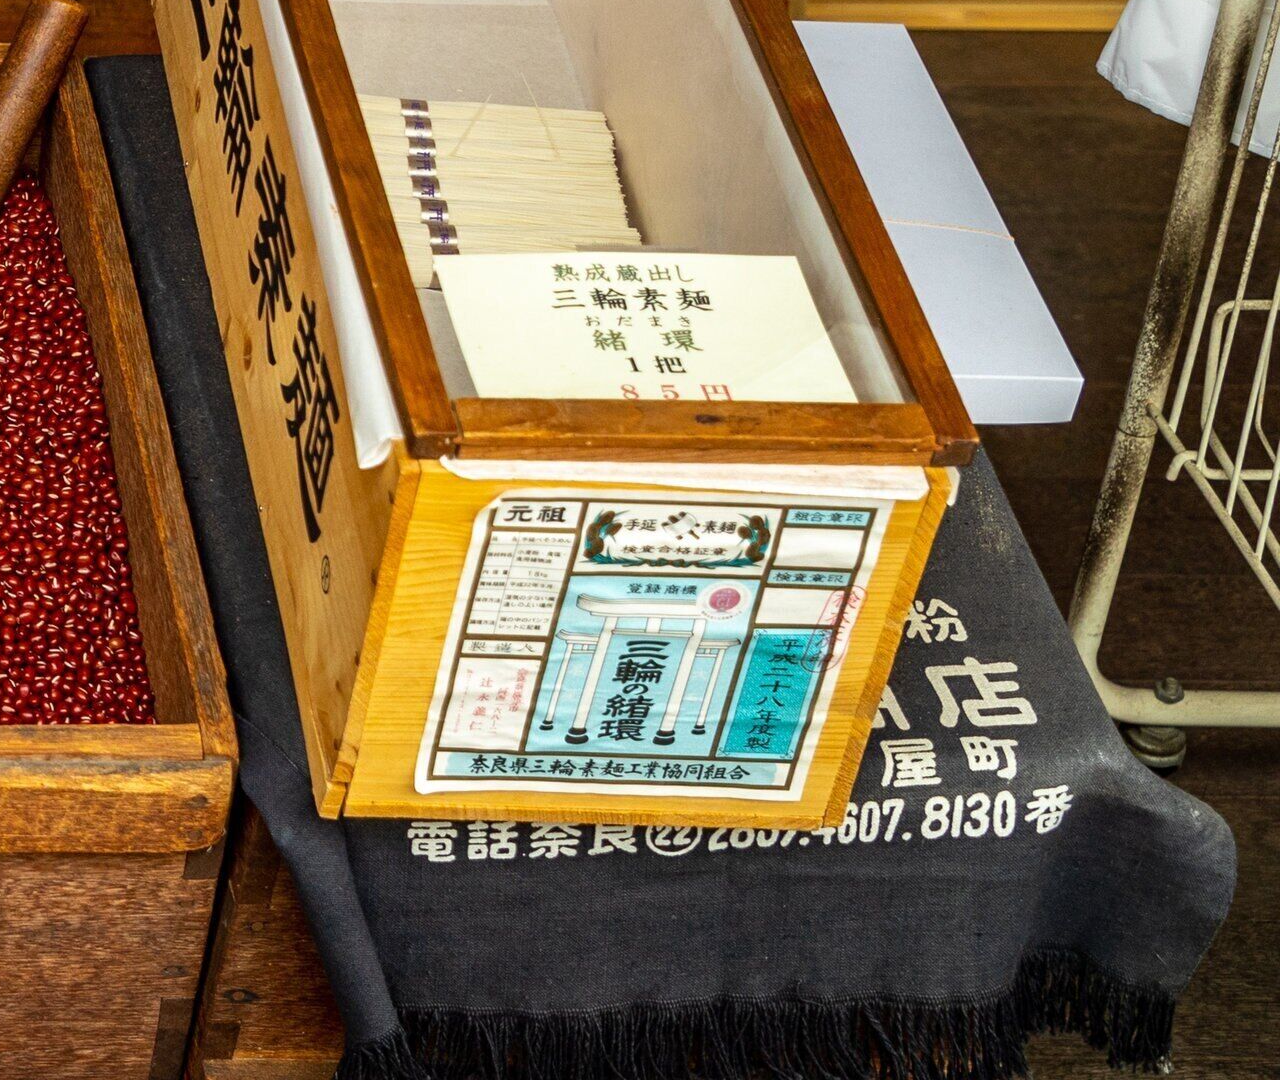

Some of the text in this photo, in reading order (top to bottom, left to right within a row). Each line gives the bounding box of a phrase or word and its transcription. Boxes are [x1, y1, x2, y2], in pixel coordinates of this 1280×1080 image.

[550, 262, 695, 284] 熟成蔵出し
[550, 287, 714, 313] 三輪素麺
[585, 315, 693, 328] おだまき
[502, 505, 567, 524] 元祖
[624, 518, 658, 532] 手延
[626, 582, 698, 596] 登録商標
[906, 598, 969, 644] 粉
[597, 639, 671, 742] 三輪の緒環
[743, 638, 805, 751] 平成二十八年度製
[470, 753, 752, 782] 奈良県三輪素麺工業協同組合
[880, 735, 1019, 788] 屋町
